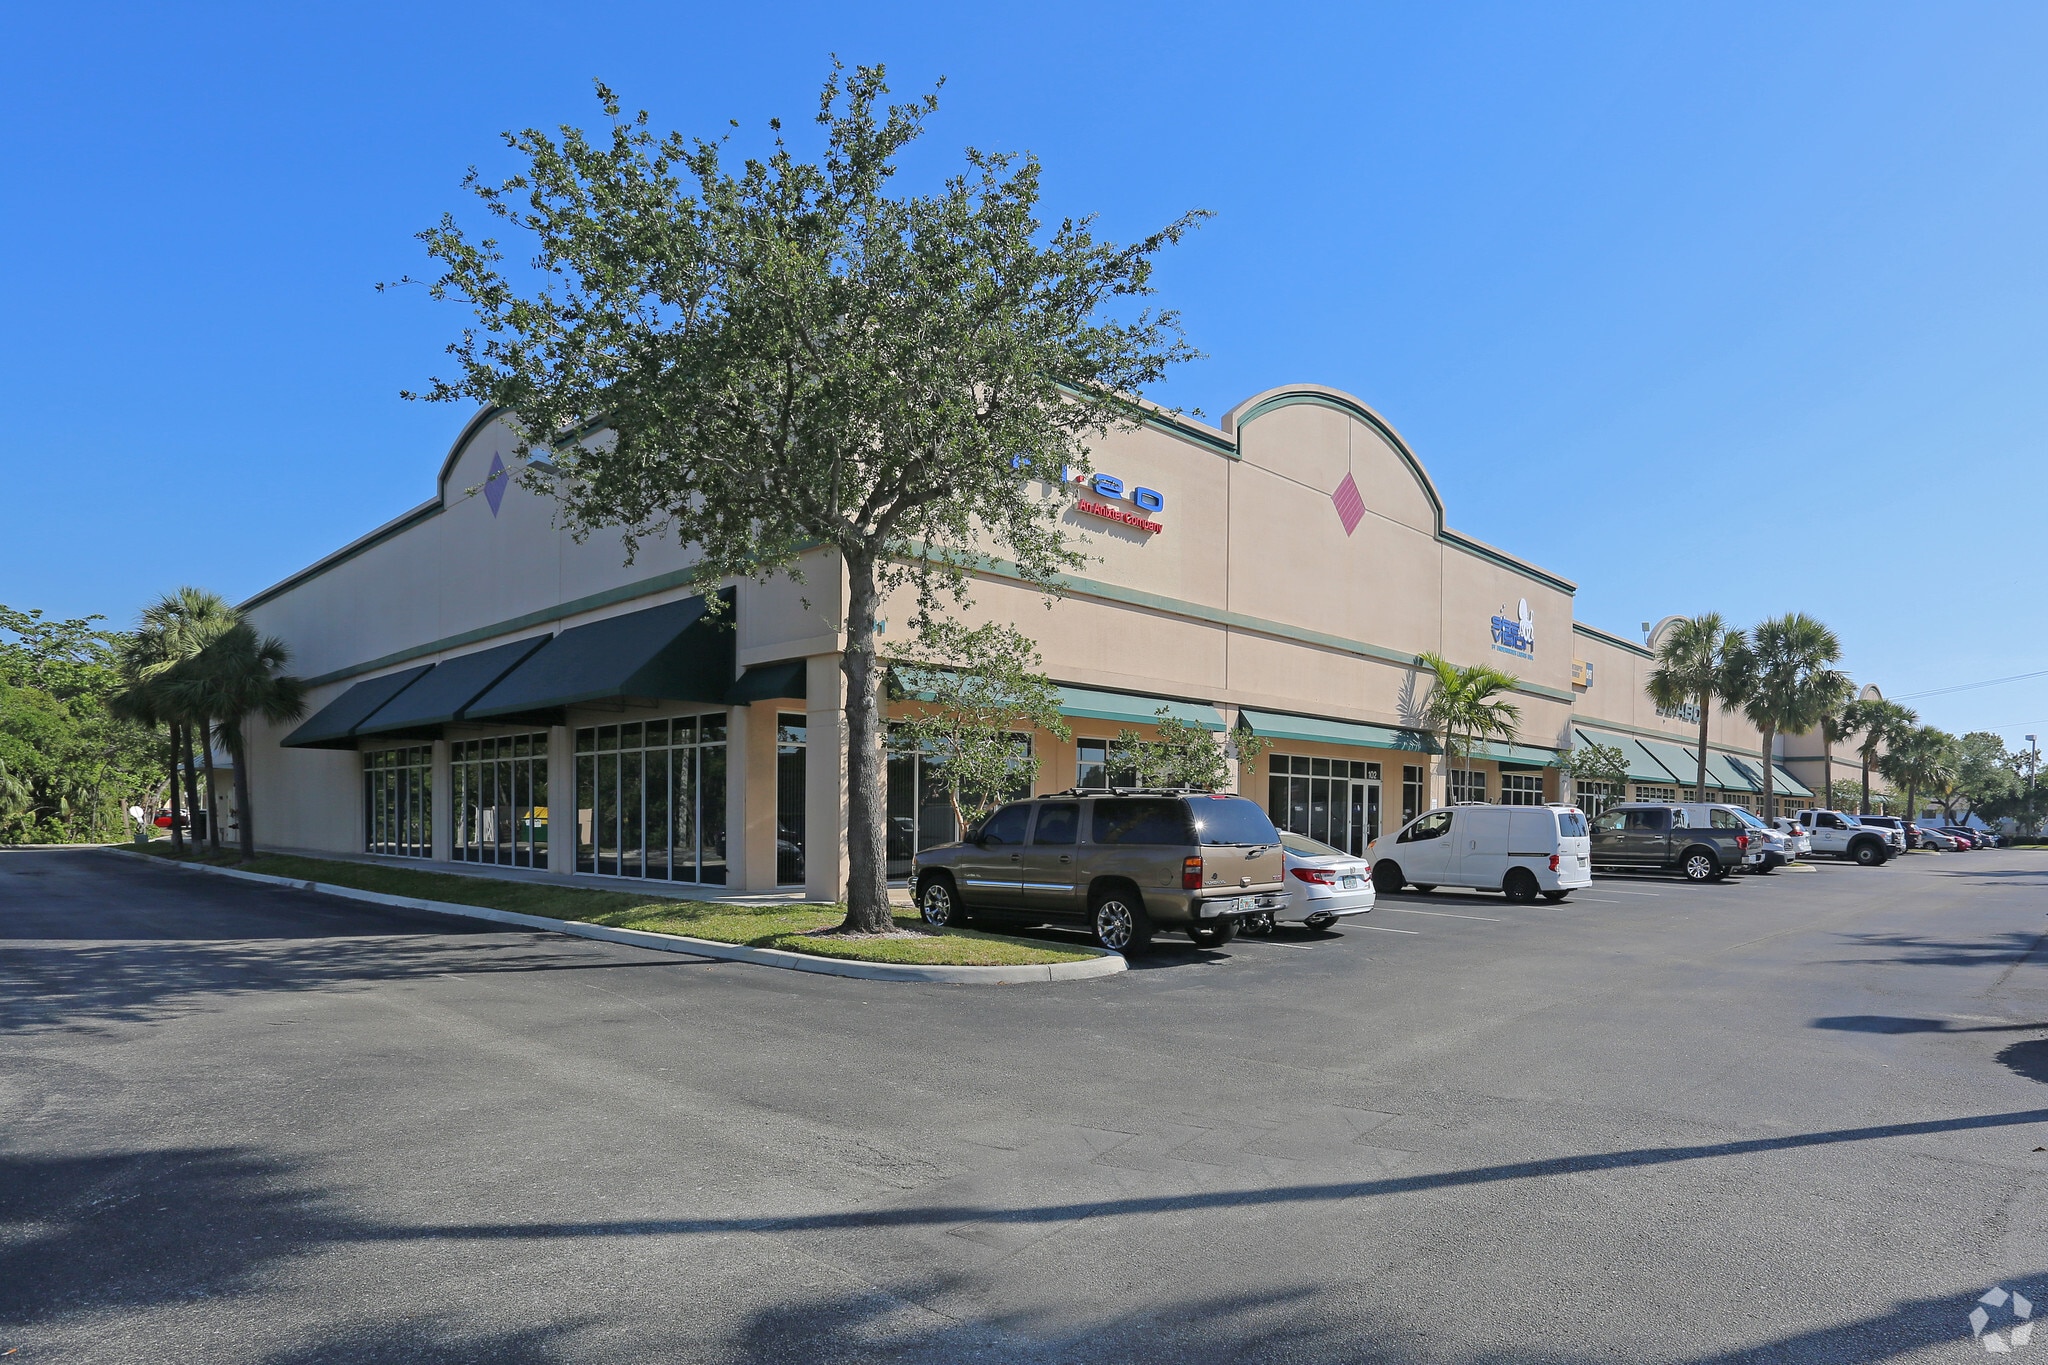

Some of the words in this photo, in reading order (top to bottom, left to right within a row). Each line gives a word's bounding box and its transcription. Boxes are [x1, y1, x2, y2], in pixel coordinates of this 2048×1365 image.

[1078, 499, 1092, 512] An
[1094, 503, 1124, 521] Anixter
[1123, 511, 1163, 534] Company
